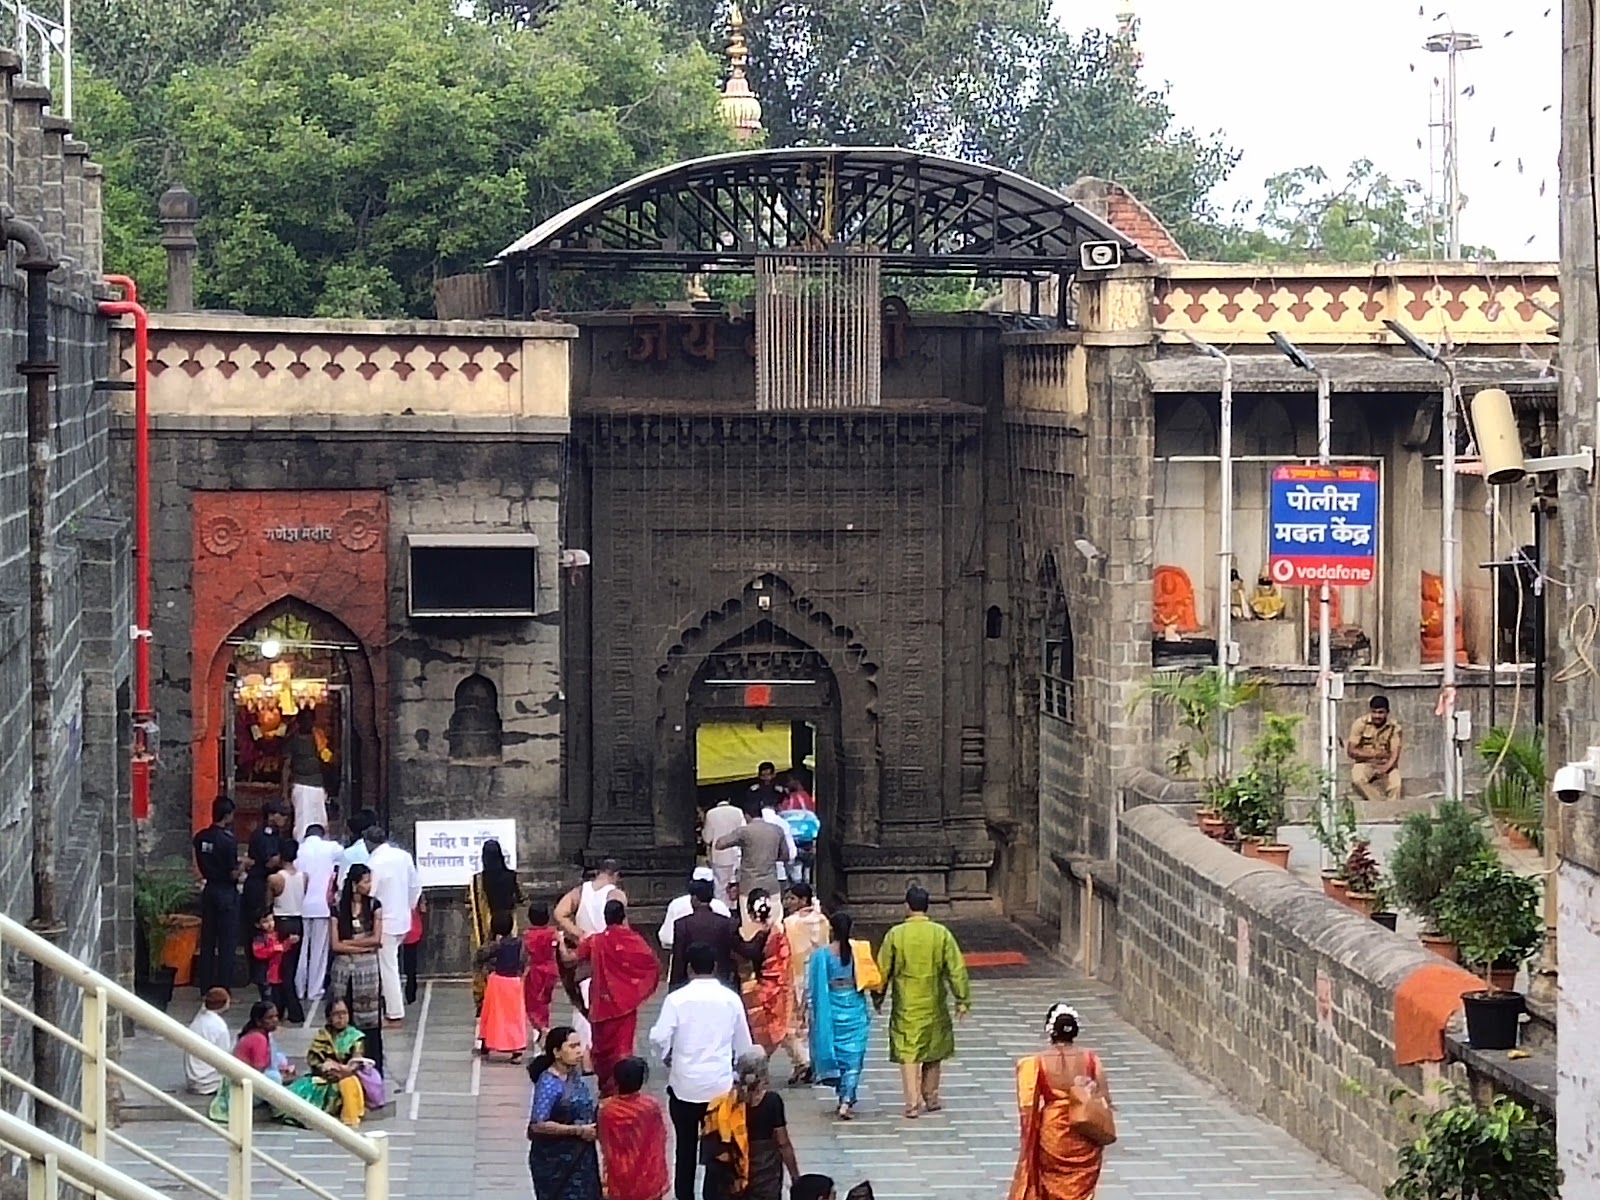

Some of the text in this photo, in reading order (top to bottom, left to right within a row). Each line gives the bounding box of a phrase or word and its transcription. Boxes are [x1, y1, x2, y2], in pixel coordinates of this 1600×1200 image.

[1286, 484, 1361, 512] पोलीस
[263, 524, 299, 542] गणेश
[1274, 516, 1372, 546] मदत केंद्र
[1296, 564, 1371, 581] vodafone
